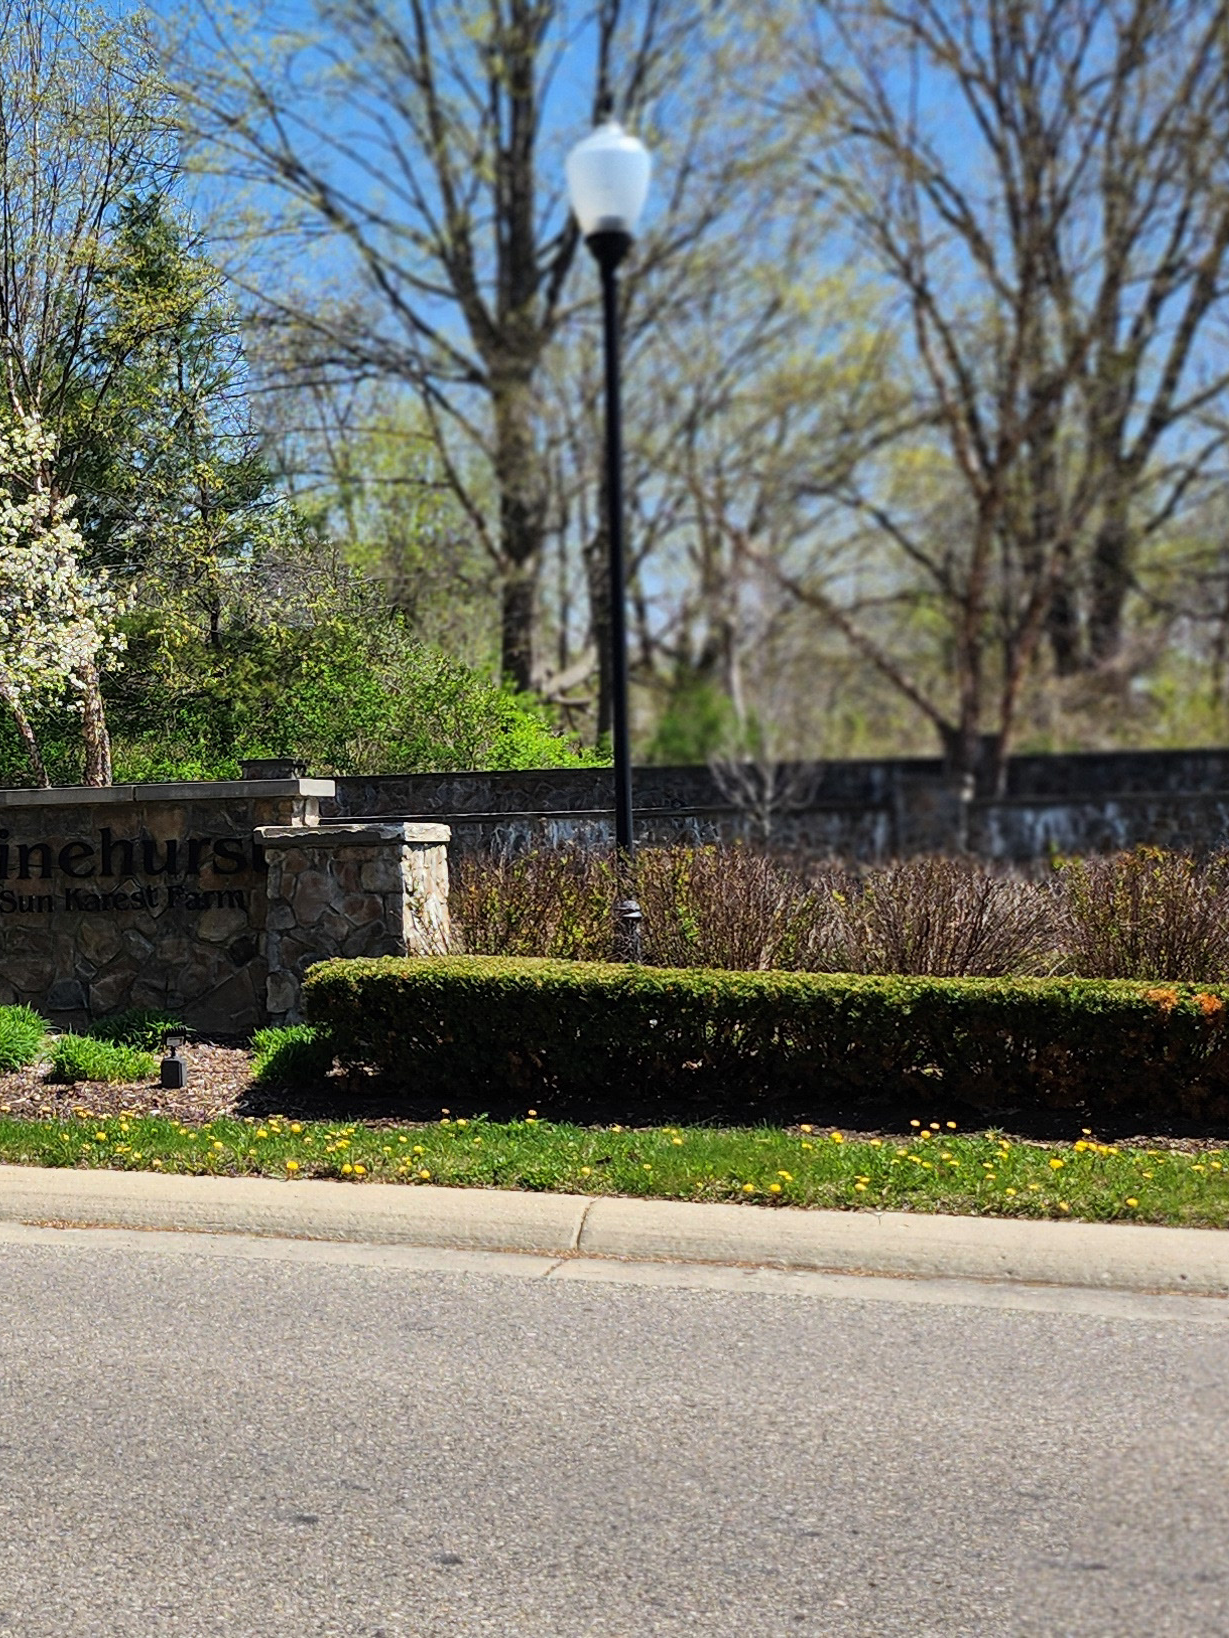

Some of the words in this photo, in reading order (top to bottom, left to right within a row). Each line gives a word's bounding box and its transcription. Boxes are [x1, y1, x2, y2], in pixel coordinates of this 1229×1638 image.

[0, 890, 53, 913] Sun
[65, 885, 160, 912] Karest
[167, 885, 245, 909] Farm
